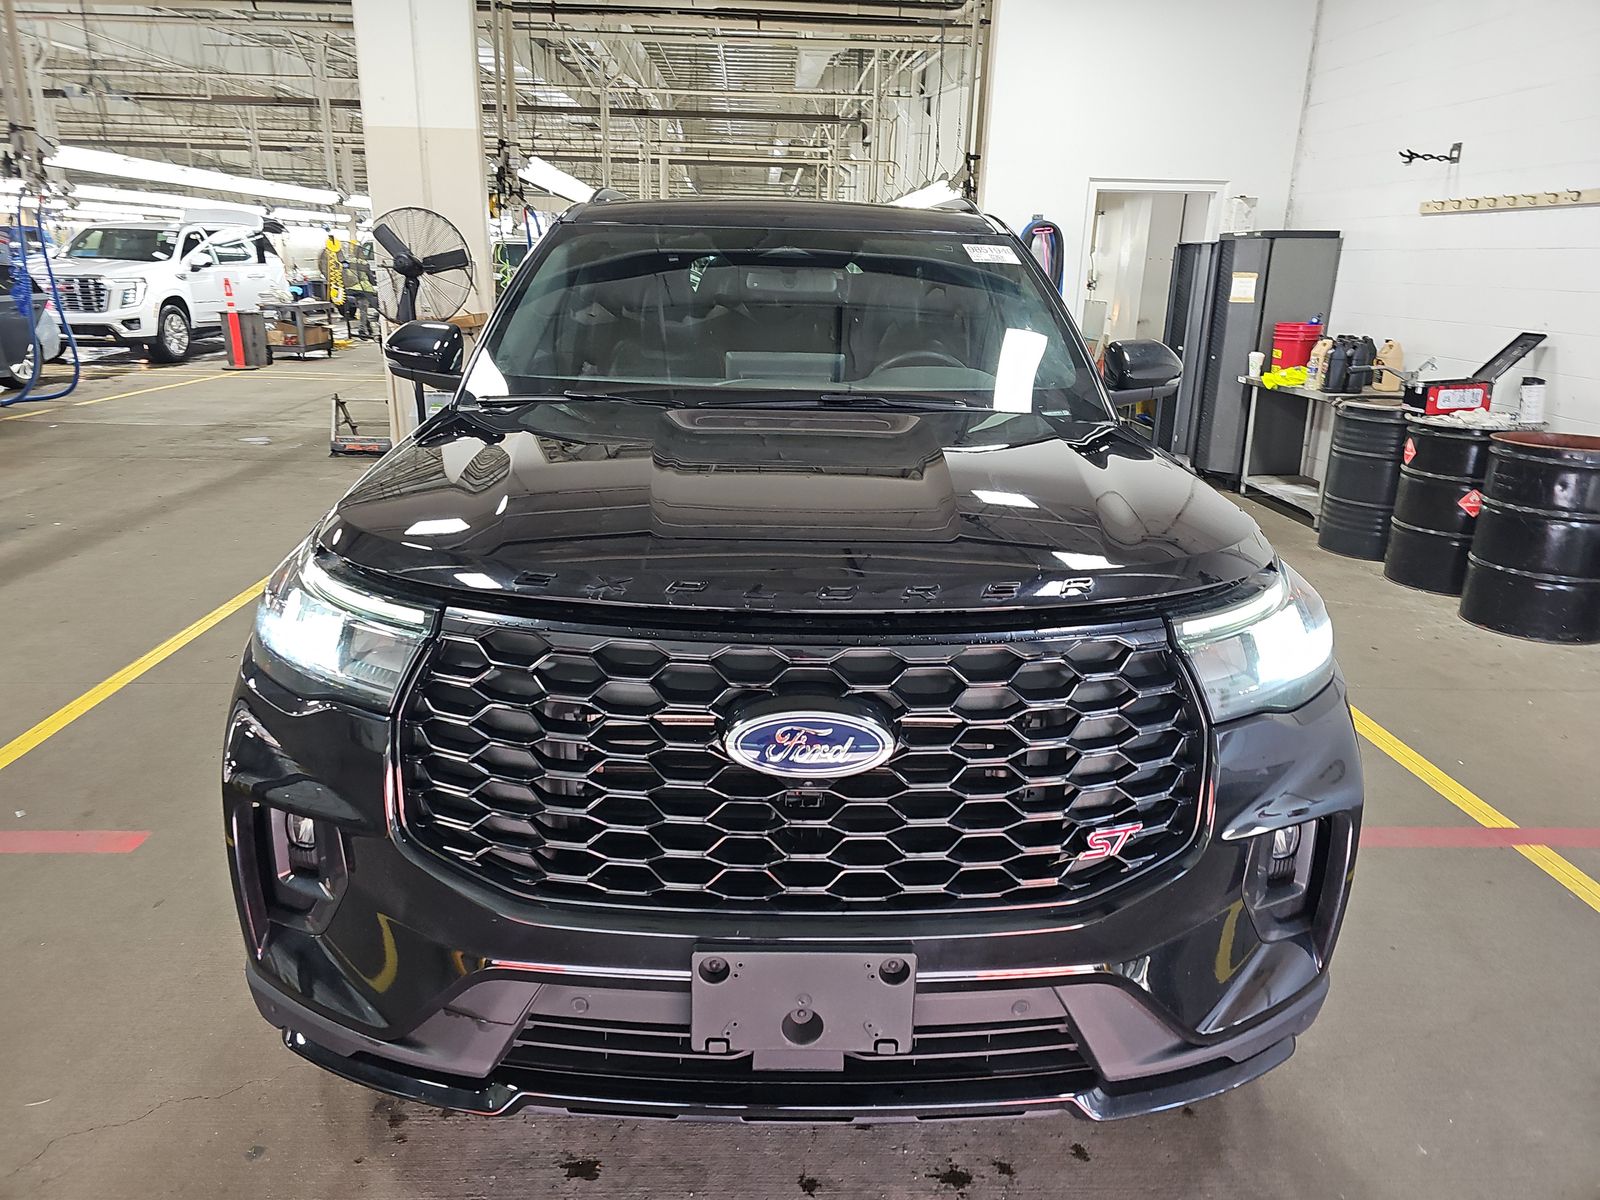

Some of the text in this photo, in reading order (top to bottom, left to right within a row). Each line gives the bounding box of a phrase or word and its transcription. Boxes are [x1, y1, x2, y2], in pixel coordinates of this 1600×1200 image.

[513, 570, 1096, 601] EXPLORER
[766, 725, 855, 763] Ford
[1079, 823, 1143, 860] ST
